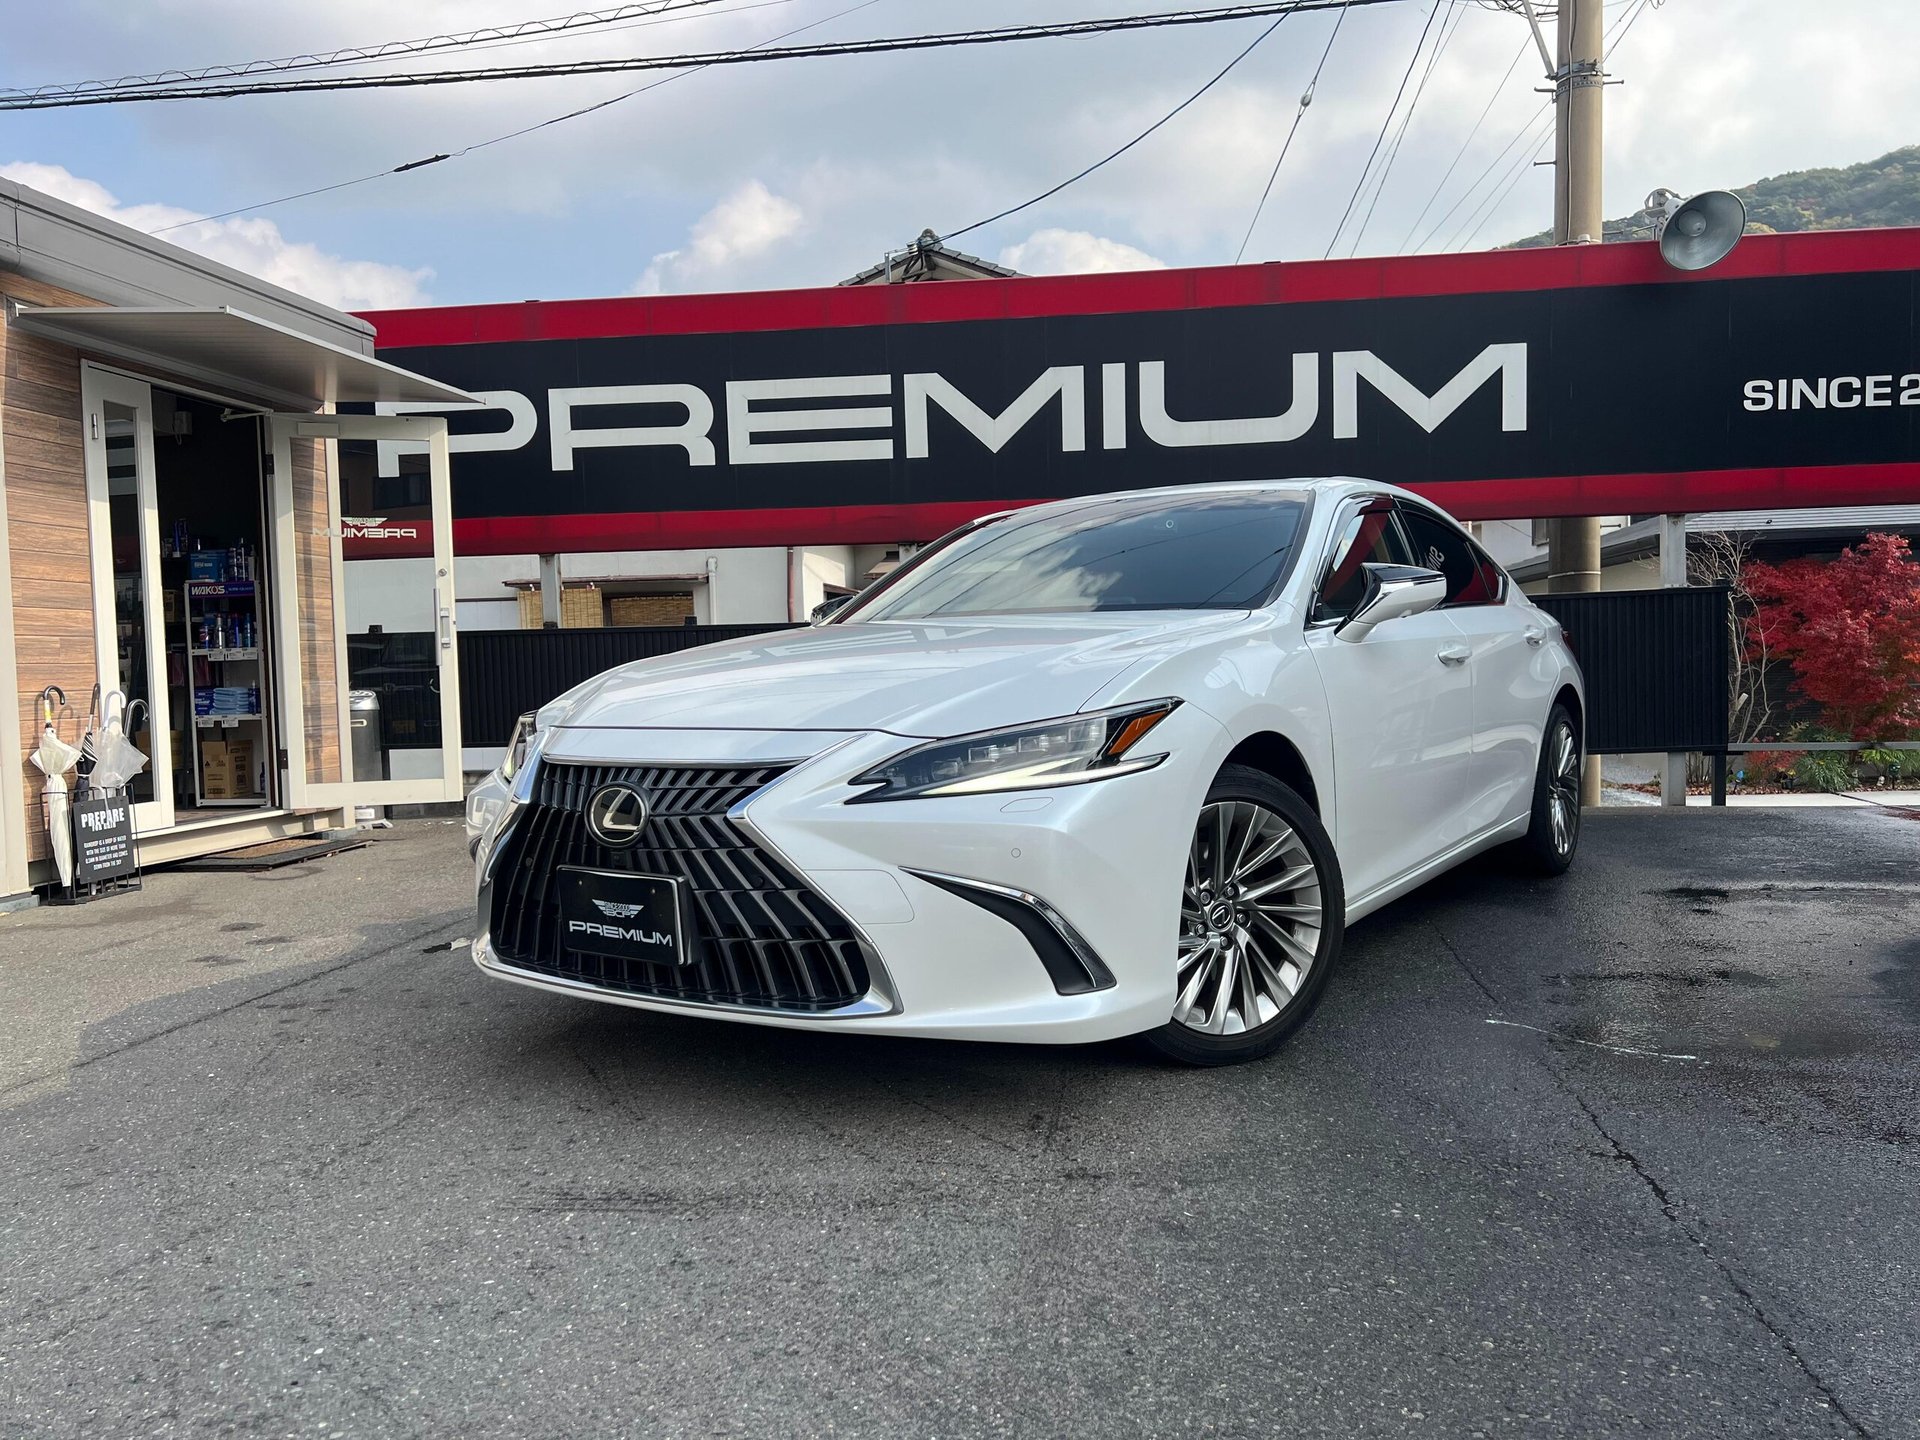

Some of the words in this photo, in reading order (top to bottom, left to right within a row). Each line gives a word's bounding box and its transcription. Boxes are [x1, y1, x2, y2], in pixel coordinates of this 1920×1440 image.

[376, 342, 1527, 478] PREMIUM
[81, 808, 125, 828] PREPARE
[568, 920, 673, 947] PREMIUM
